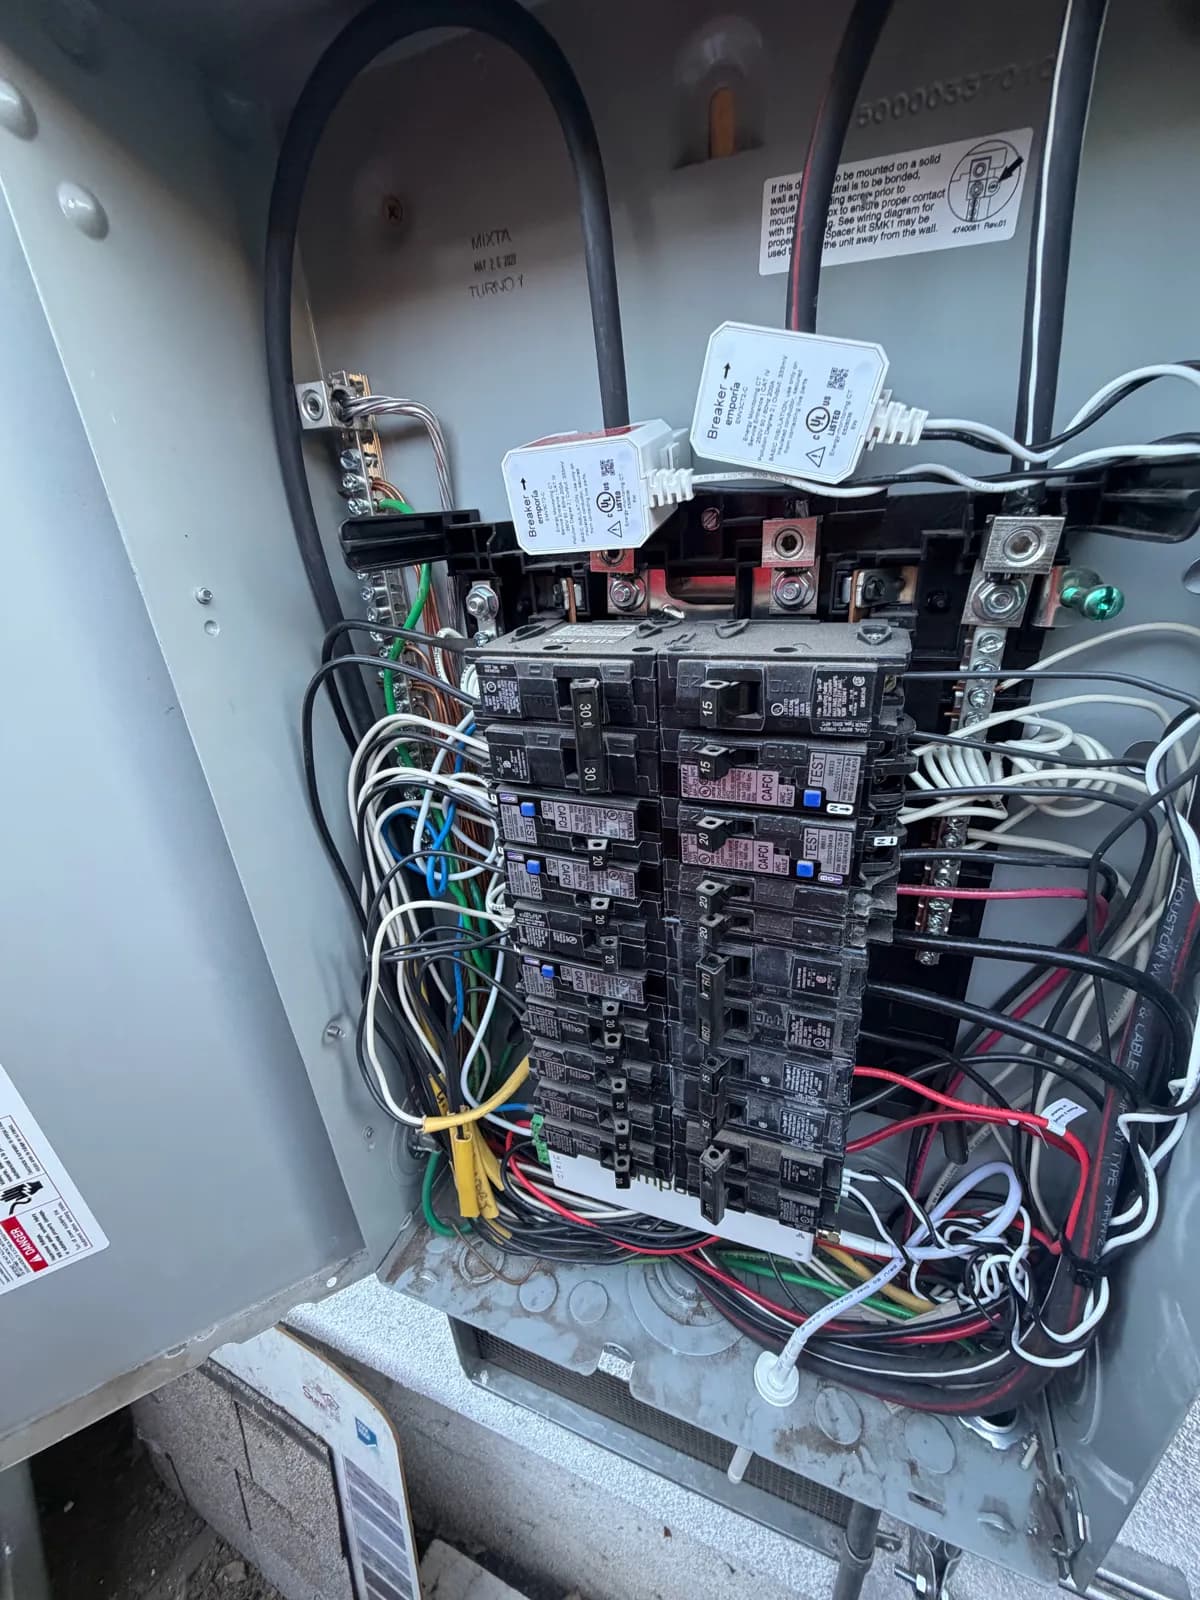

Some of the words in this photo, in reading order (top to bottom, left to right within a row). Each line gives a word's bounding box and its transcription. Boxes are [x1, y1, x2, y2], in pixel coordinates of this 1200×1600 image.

[844, 171, 854, 180] be
[856, 162, 894, 177] mounted
[896, 162, 908, 171] on
[919, 153, 942, 167] solid
[779, 183, 792, 192] this
[852, 182, 858, 191] is
[861, 180, 869, 189] to
[872, 177, 882, 187] be
[885, 170, 920, 184] bonded,
[770, 194, 786, 204] wall
[840, 206, 848, 215] to
[850, 201, 879, 213] ensure
[881, 194, 911, 209] proper
[912, 189, 945, 202] contact
[847, 191, 873, 201] screw
[874, 186, 895, 200] prior
[896, 185, 906, 194] to
[770, 204, 795, 217] torque
[838, 216, 854, 227] See
[857, 212, 882, 224] wiring
[884, 206, 920, 219] diagram
[922, 202, 935, 212] for
[471, 227, 512, 250] MIXTA
[769, 227, 784, 237] with
[824, 240, 837, 249] the
[839, 237, 854, 248] unit
[856, 234, 878, 245] away
[880, 231, 900, 241] from
[902, 228, 916, 237] the
[918, 223, 938, 234] wall.
[825, 228, 854, 239] Spacer
[856, 224, 867, 234] kit
[868, 220, 894, 232] SMK1
[897, 217, 916, 228] may
[918, 215, 930, 223] be
[768, 247, 787, 258] used
[469, 276, 514, 297] TURNO
[707, 384, 727, 439] Breaker
[828, 410, 840, 436] LISTED
[615, 491, 623, 512] LISTED
[523, 495, 537, 537] Breaker
[580, 703, 592, 718] 30
[702, 701, 713, 716] 15
[584, 767, 597, 781] 30
[700, 760, 711, 774] 15
[810, 754, 825, 784] TEST
[761, 774, 773, 802] CAFCI
[556, 805, 568, 828] CAFCI
[525, 818, 536, 843] TEST
[700, 834, 709, 845] 20
[806, 830, 817, 858] TEST
[592, 856, 603, 867] 20
[758, 844, 770, 870] CAFCI
[560, 863, 572, 886] CAFCI
[532, 875, 541, 898] TEST
[595, 915, 605, 925] 20
[1157, 876, 1190, 961] HOUSTON
[605, 955, 615, 965] 20
[605, 1019, 615, 1028] 20
[1126, 1022, 1145, 1071] CABLE
[605, 1056, 614, 1064] 20
[1107, 1153, 1121, 1187] TYPE
[10, 1228, 35, 1255] DANGER
